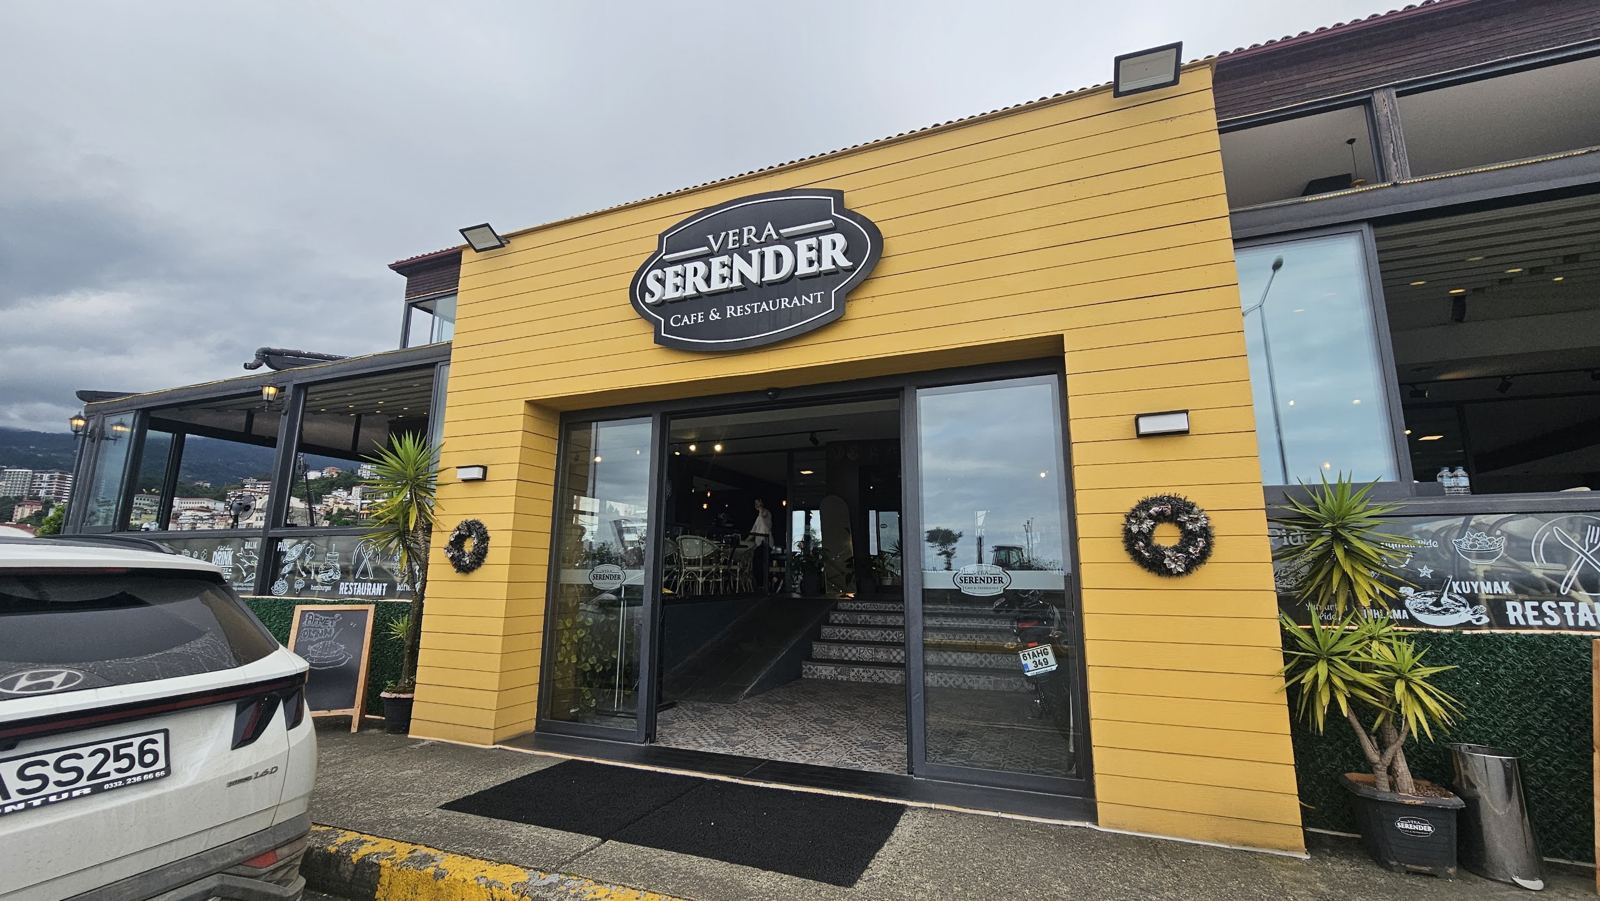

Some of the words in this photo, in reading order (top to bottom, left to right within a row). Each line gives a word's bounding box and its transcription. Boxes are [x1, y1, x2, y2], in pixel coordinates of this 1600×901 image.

[706, 221, 779, 253] VERA
[645, 232, 853, 305] SERENDER
[670, 311, 705, 327] CAFE
[709, 308, 722, 321] &
[726, 291, 825, 318] RESTAURANT
[339, 582, 387, 596] RESTAURANT
[959, 576, 1004, 585] SERENDER
[1452, 581, 1513, 594] KUYMAK
[1505, 601, 1600, 627] RESTA
[1033, 658, 1049, 668] 349
[0, 787, 92, 813] NTUR
[126, 777, 142, 785] 236
[143, 773, 154, 781] 66
[155, 770, 165, 778] 66
[1397, 822, 1433, 832] SERENDER
